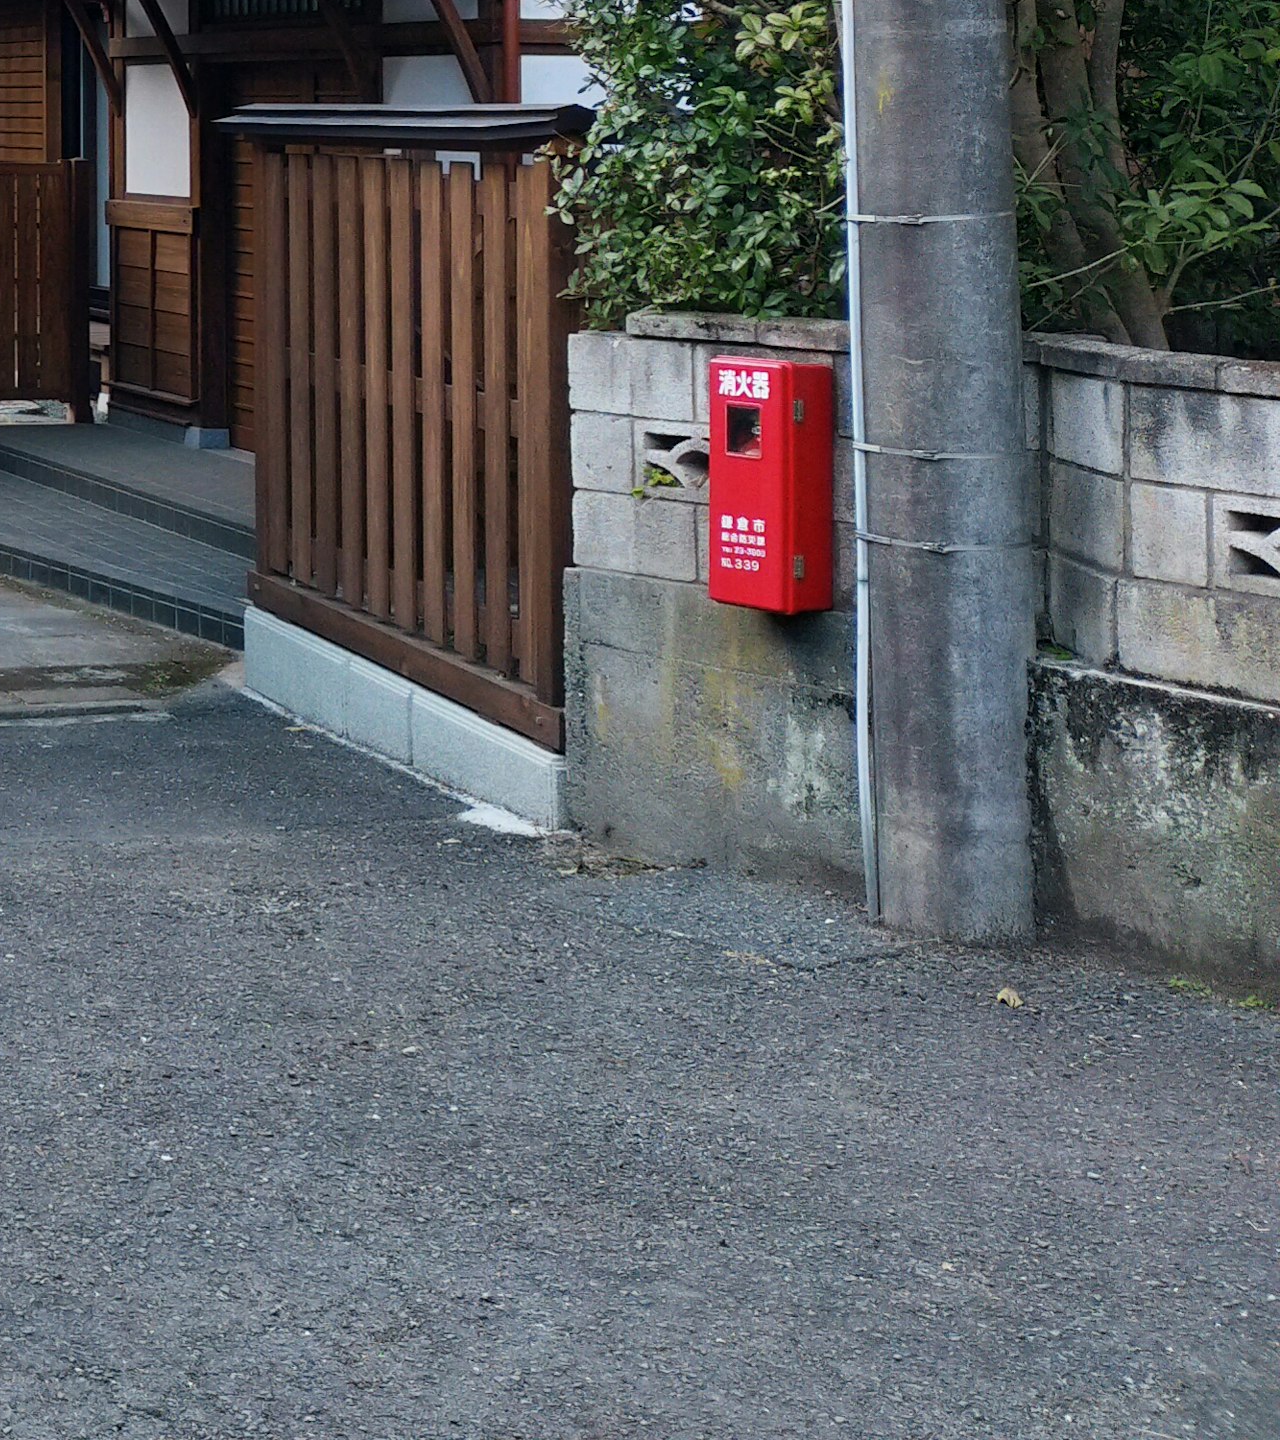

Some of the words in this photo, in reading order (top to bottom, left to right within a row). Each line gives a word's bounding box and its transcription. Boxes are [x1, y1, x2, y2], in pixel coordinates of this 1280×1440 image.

[718, 369, 770, 399] 消火器
[721, 514, 766, 533] 鎌倉市
